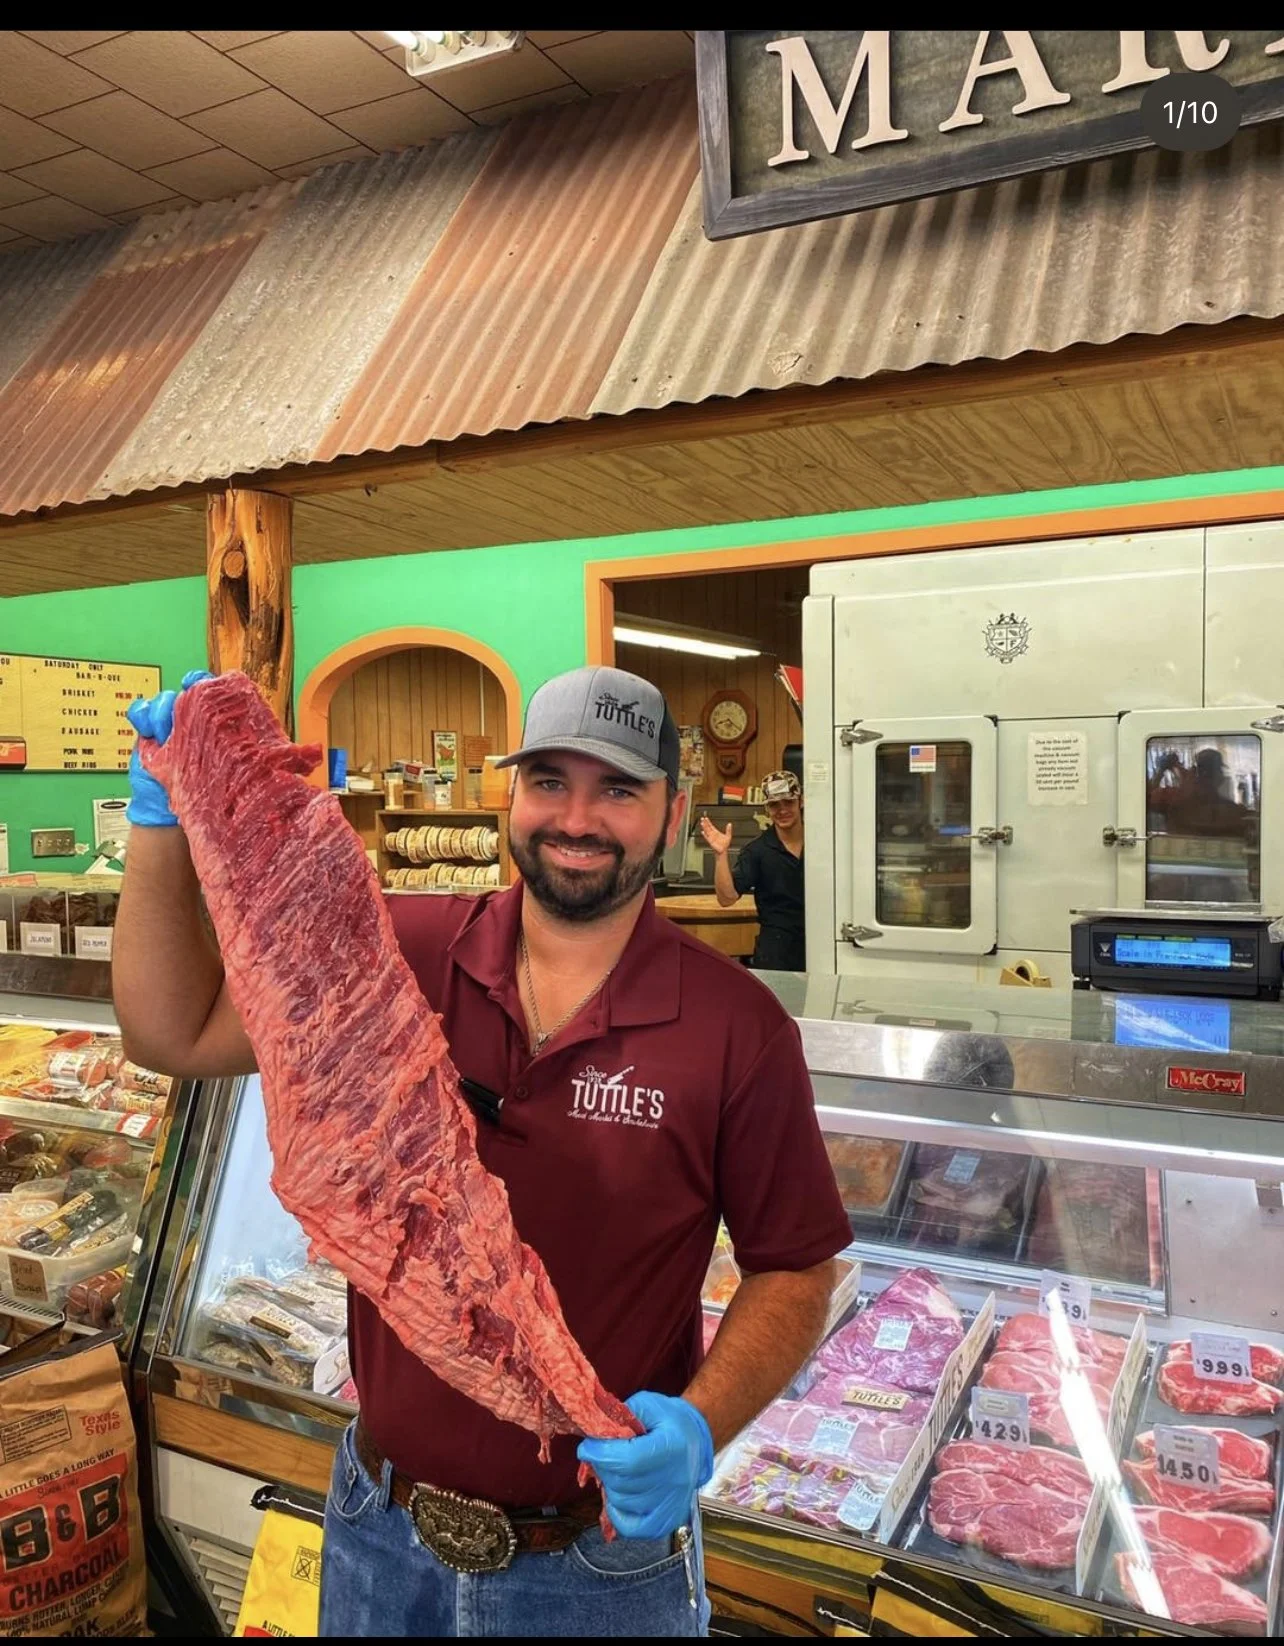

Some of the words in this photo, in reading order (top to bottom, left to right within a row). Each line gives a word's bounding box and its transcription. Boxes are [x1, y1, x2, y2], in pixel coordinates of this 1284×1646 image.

[44, 660, 79, 669] SATURDAY
[88, 663, 103, 671] ONLY
[62, 689, 95, 697] BRISKET
[62, 708, 98, 717] CHICKEN
[595, 700, 655, 739] TUTTLE'S
[61, 727, 99, 736] SAUSAGE
[1170, 1071, 1240, 1092] McCray
[571, 1079, 665, 1120] TUTTLE'S
[80, 1410, 120, 1426] Texas
[86, 1420, 120, 1436] Style
[5, 1479, 34, 1496] LITTLE
[37, 1470, 61, 1485] GOES
[63, 1467, 70, 1476] A
[71, 1456, 97, 1471] LONG
[97, 1448, 115, 1461] WAY
[0, 1505, 52, 1571] B
[54, 1503, 77, 1542] &
[78, 1473, 121, 1542] B
[262, 1620, 268, 1629] A
